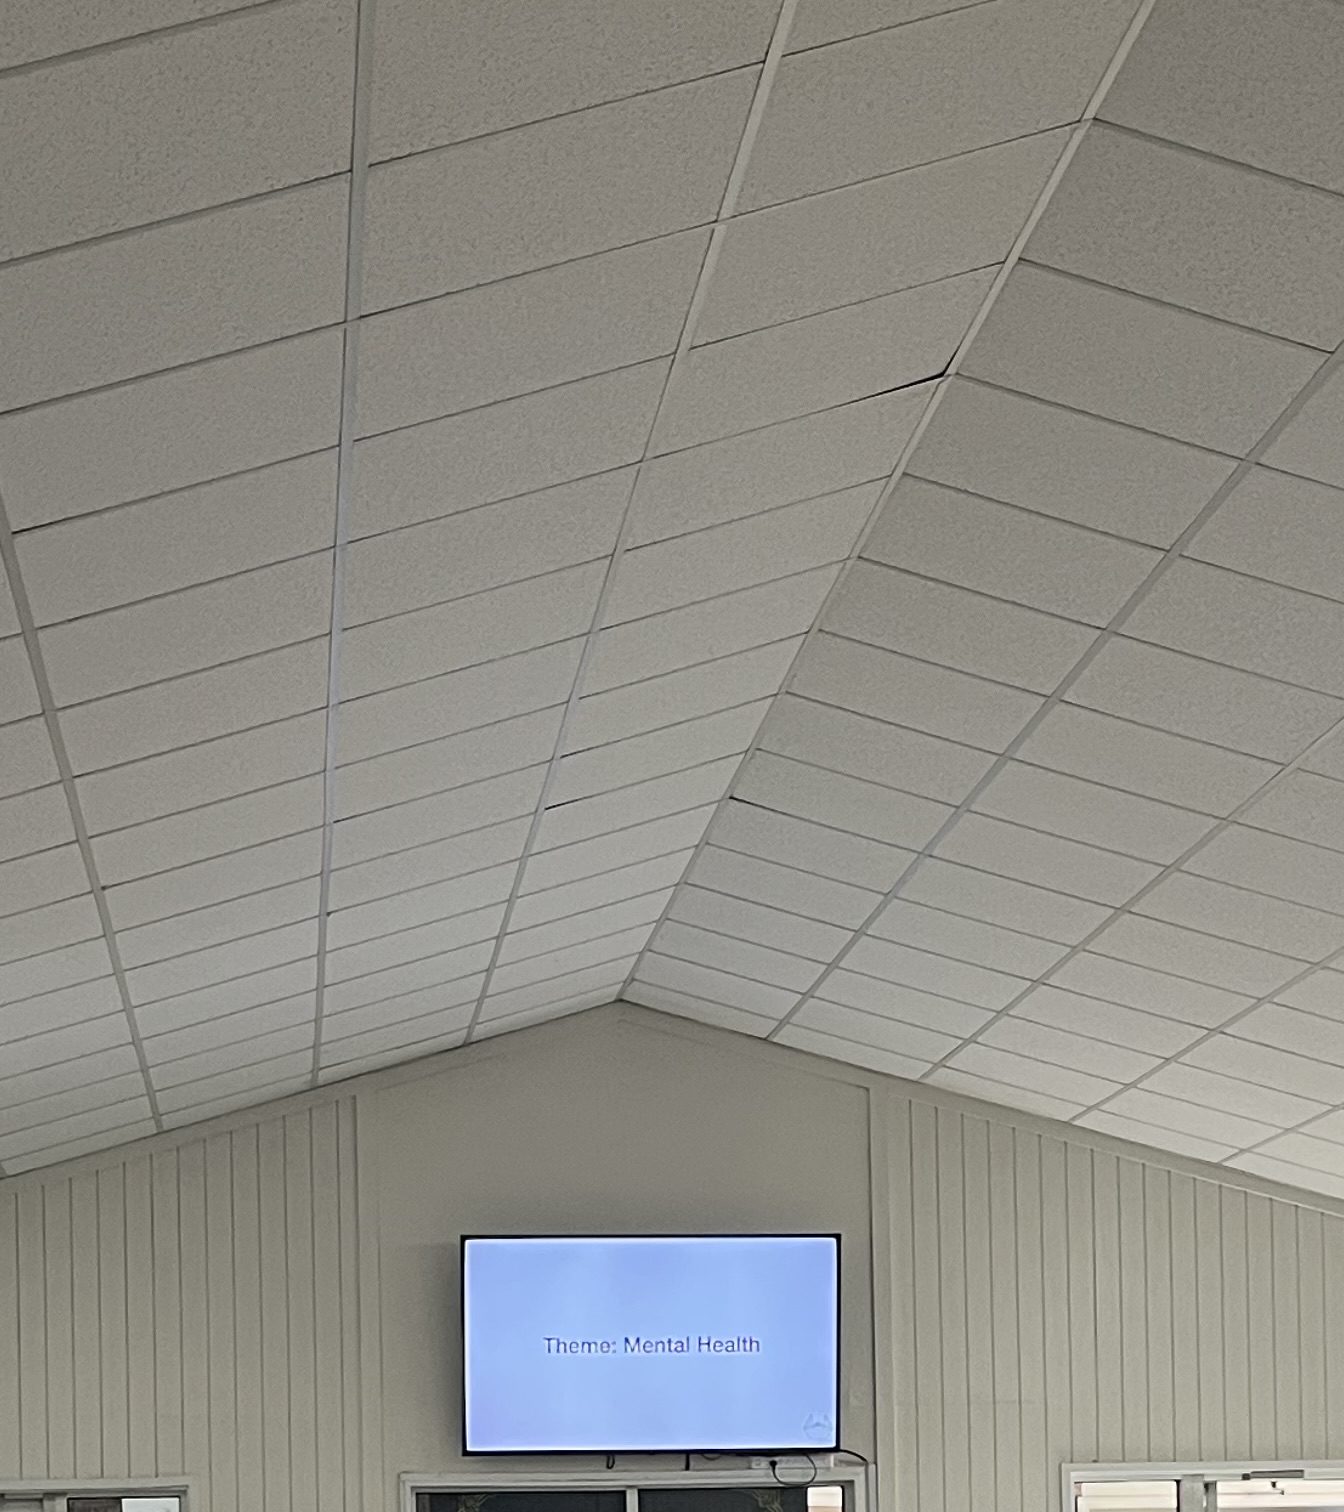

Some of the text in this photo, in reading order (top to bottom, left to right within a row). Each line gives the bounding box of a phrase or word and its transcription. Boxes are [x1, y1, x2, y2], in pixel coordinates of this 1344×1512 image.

[543, 1335, 761, 1354] Theme: Mental Health
